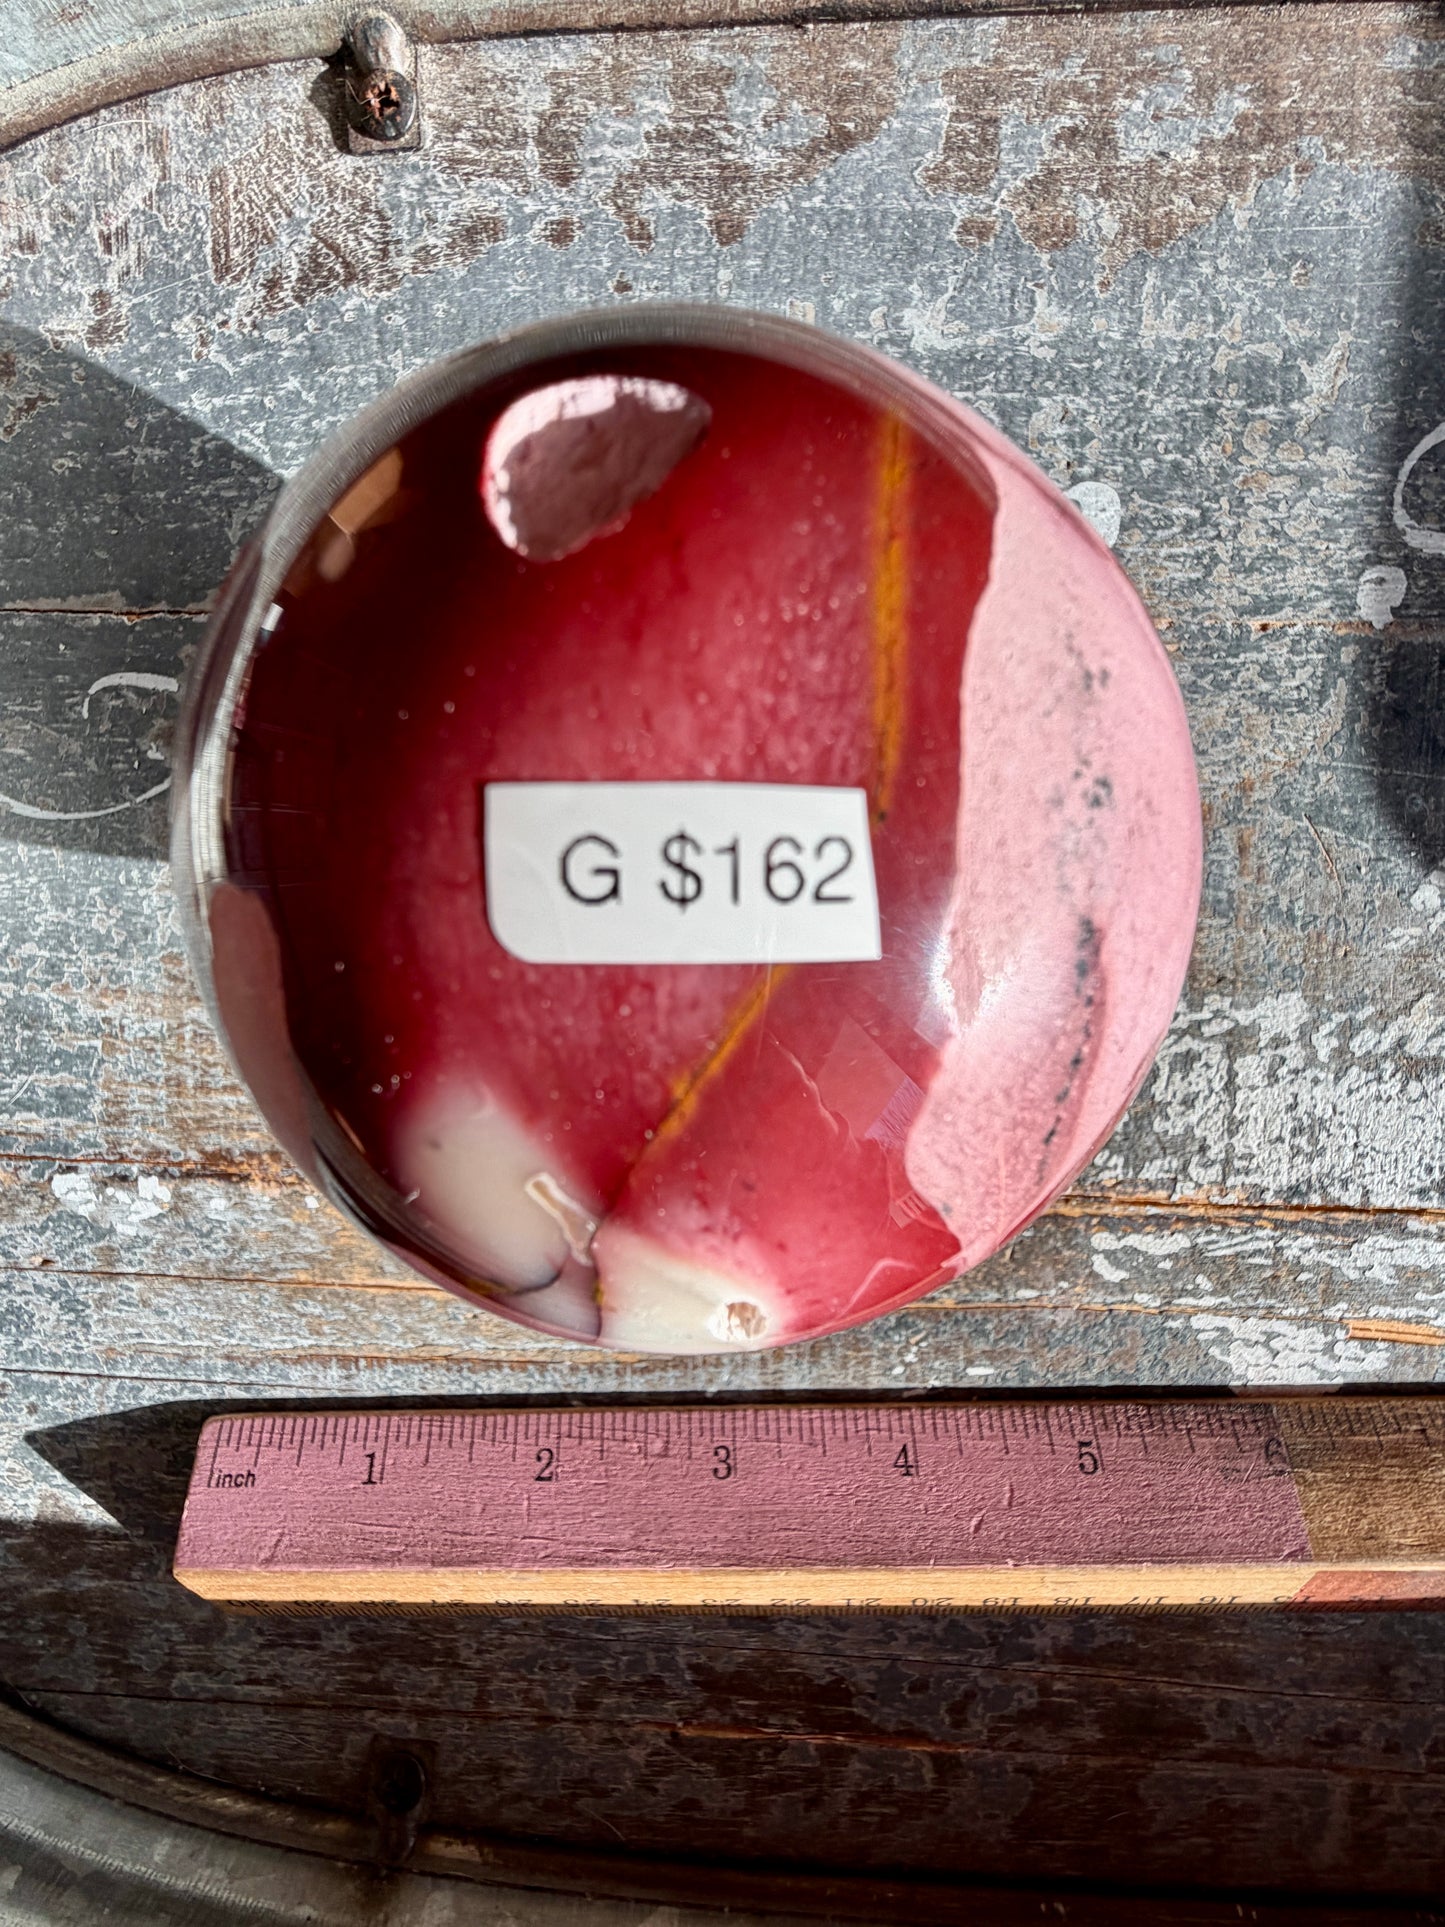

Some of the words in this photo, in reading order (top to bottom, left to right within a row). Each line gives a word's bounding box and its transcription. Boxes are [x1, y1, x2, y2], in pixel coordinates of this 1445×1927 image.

[559, 832, 622, 906] G
[657, 824, 855, 914] $162
[215, 1468, 256, 1488] inch
[361, 1451, 378, 1485] 1
[534, 1448, 555, 1482] 2
[712, 1446, 733, 1480] 3
[893, 1443, 914, 1476] 4
[1078, 1440, 1099, 1475] 5
